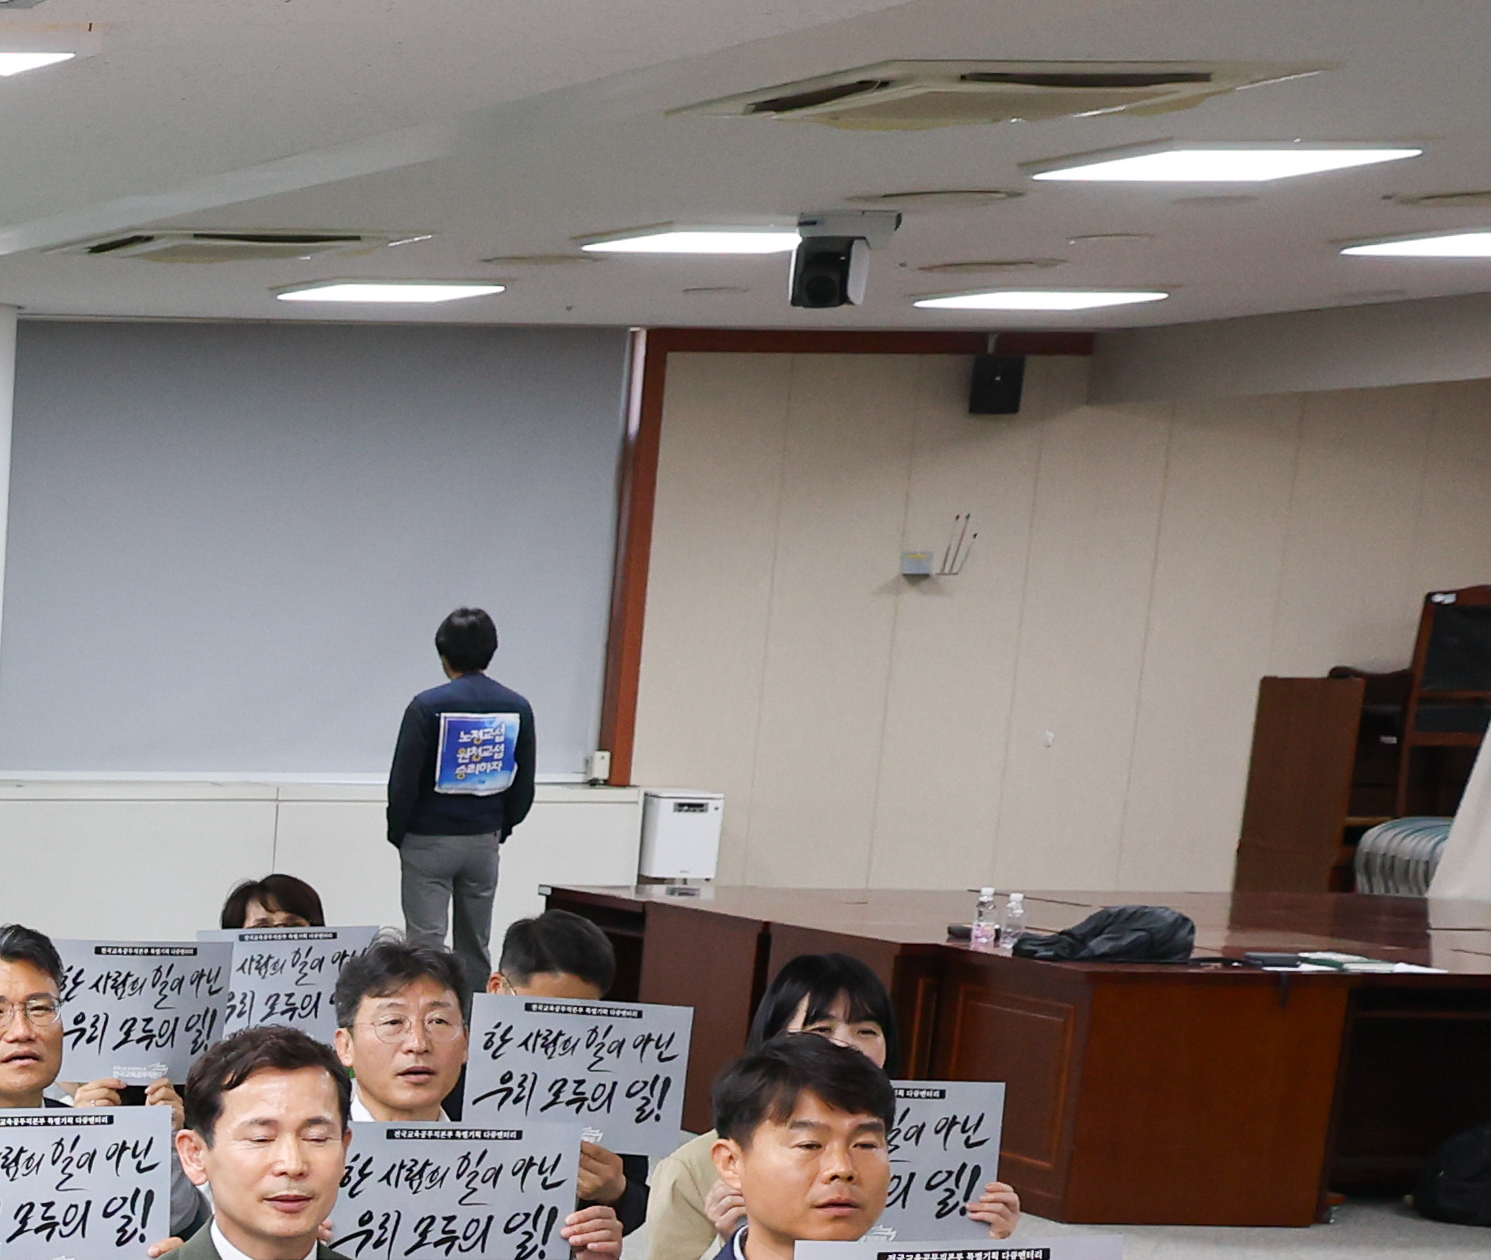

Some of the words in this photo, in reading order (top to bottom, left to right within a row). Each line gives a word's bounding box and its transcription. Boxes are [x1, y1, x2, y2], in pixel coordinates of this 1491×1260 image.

[455, 760, 503, 780] 승리하자
[483, 1021, 513, 1060] 한
[517, 1029, 580, 1059] 사람의
[585, 1024, 625, 1071] 일이
[633, 1032, 678, 1064] 아닌
[472, 1070, 537, 1116] 우리
[540, 1078, 618, 1114] 모두의
[625, 1073, 670, 1123] 일!
[51, 1134, 96, 1191] 일이
[106, 1136, 159, 1177] 아닌
